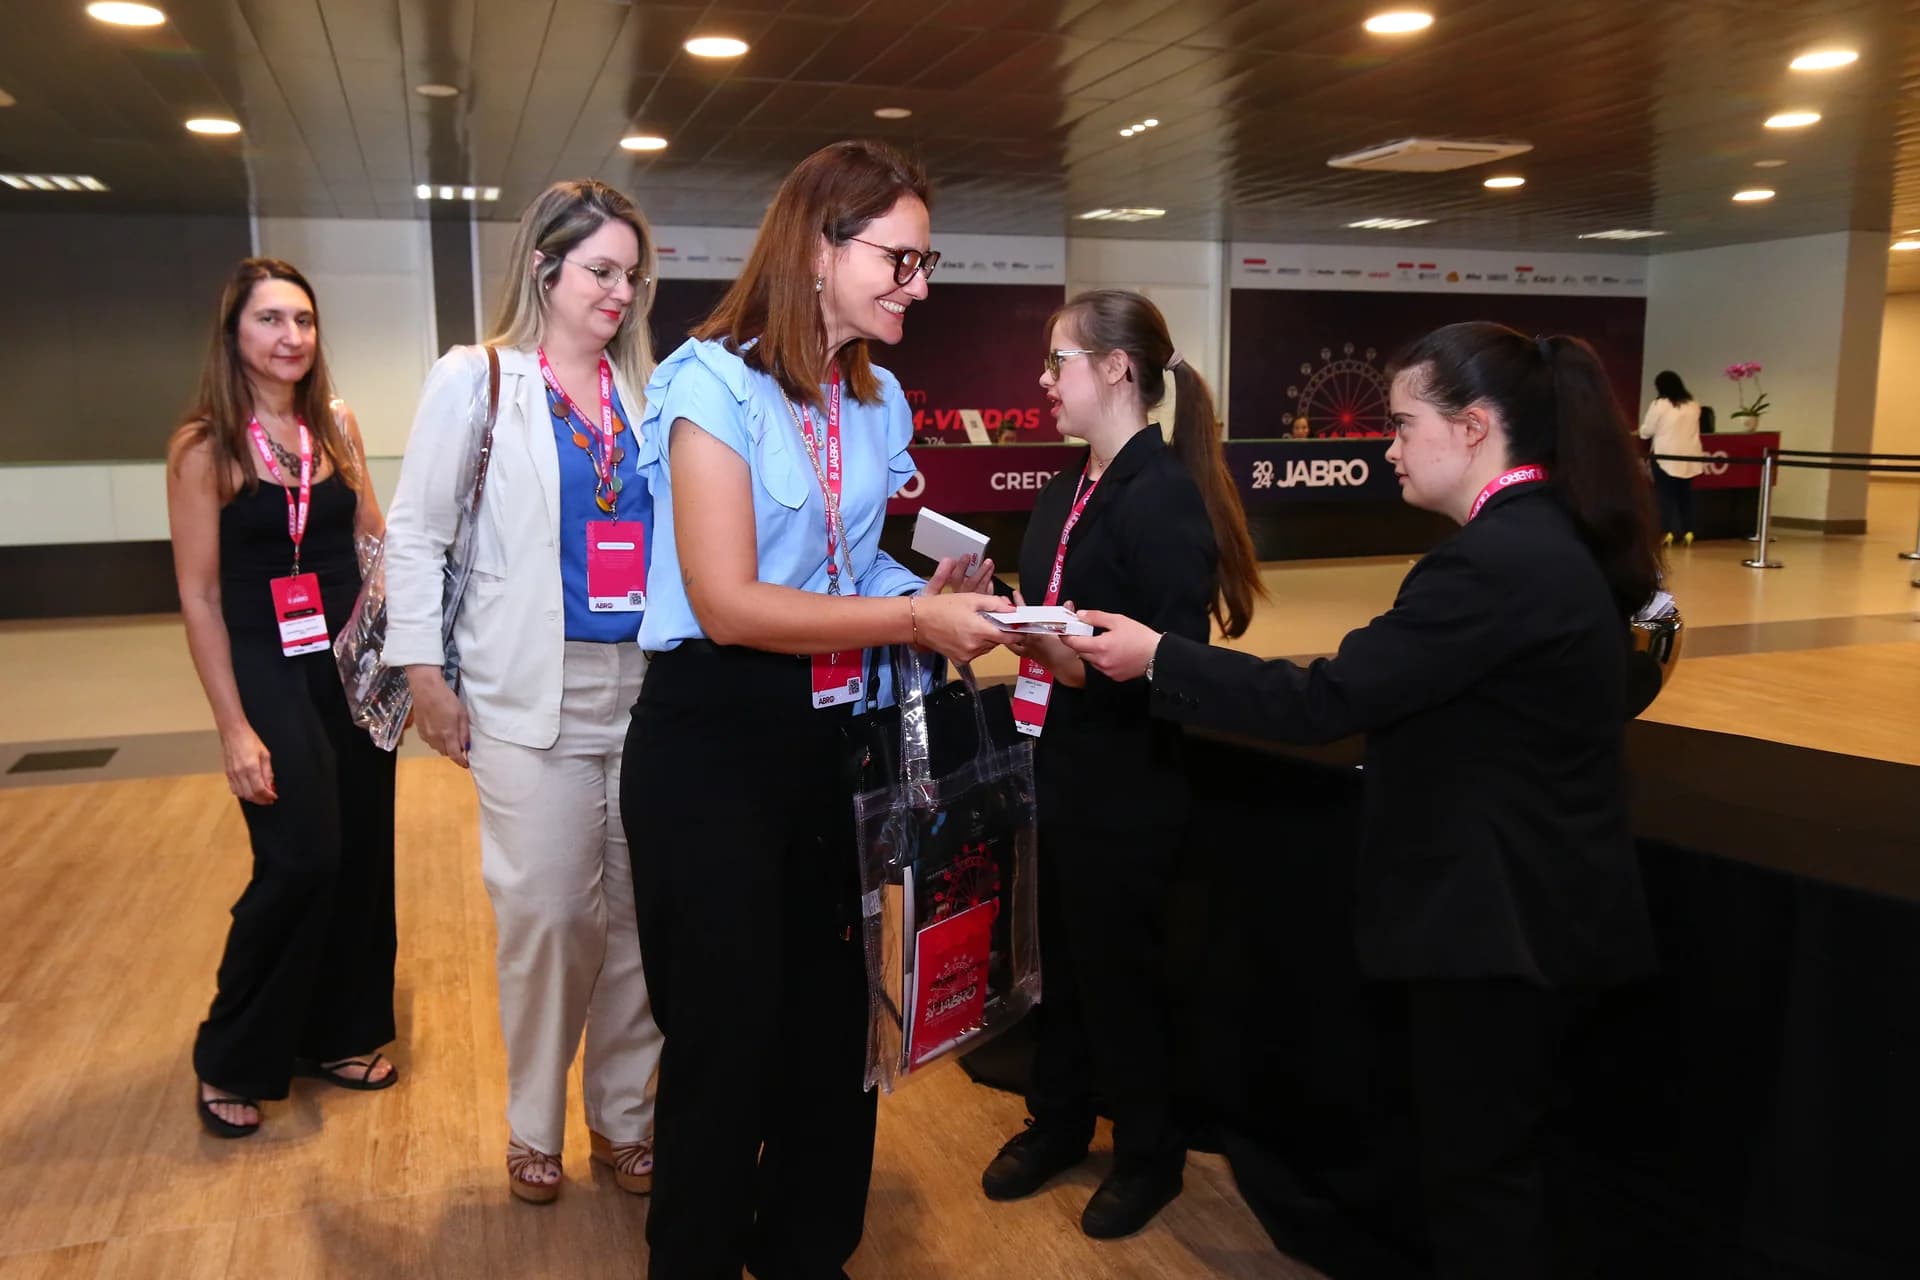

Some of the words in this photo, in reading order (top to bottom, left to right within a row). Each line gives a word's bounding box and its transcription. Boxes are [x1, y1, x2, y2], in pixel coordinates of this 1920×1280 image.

[829, 436, 839, 471] JABRO
[1252, 461, 1273, 475] 20
[1277, 459, 1369, 487] JABRO
[990, 471, 1061, 490] CRED
[1252, 473, 1273, 488] 24
[819, 695, 834, 705] ABRO
